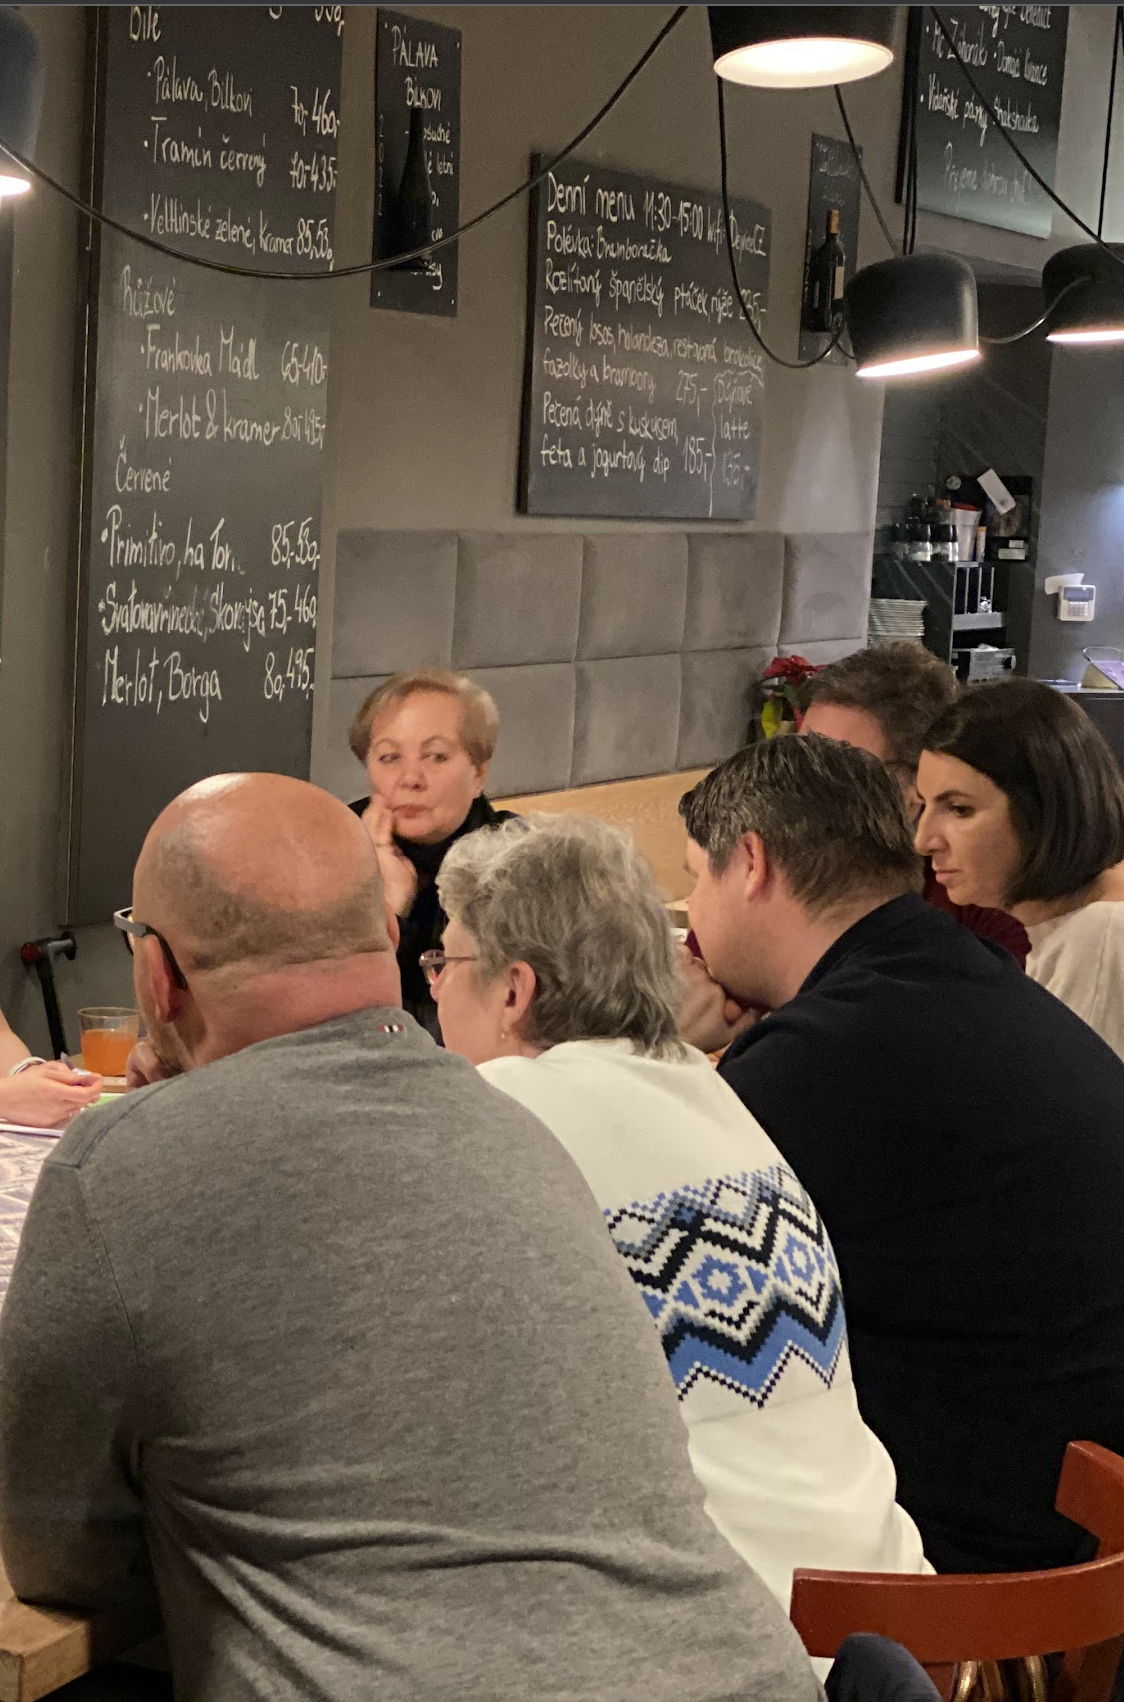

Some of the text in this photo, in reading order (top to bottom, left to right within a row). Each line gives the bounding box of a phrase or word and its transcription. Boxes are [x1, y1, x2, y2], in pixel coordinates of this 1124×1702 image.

[547, 171, 590, 216] Denní
[595, 188, 636, 223] menu
[544, 305, 584, 348] Pečený
[146, 385, 202, 439] Merlot
[543, 390, 583, 430] Pečená
[114, 434, 172, 493] Červené
